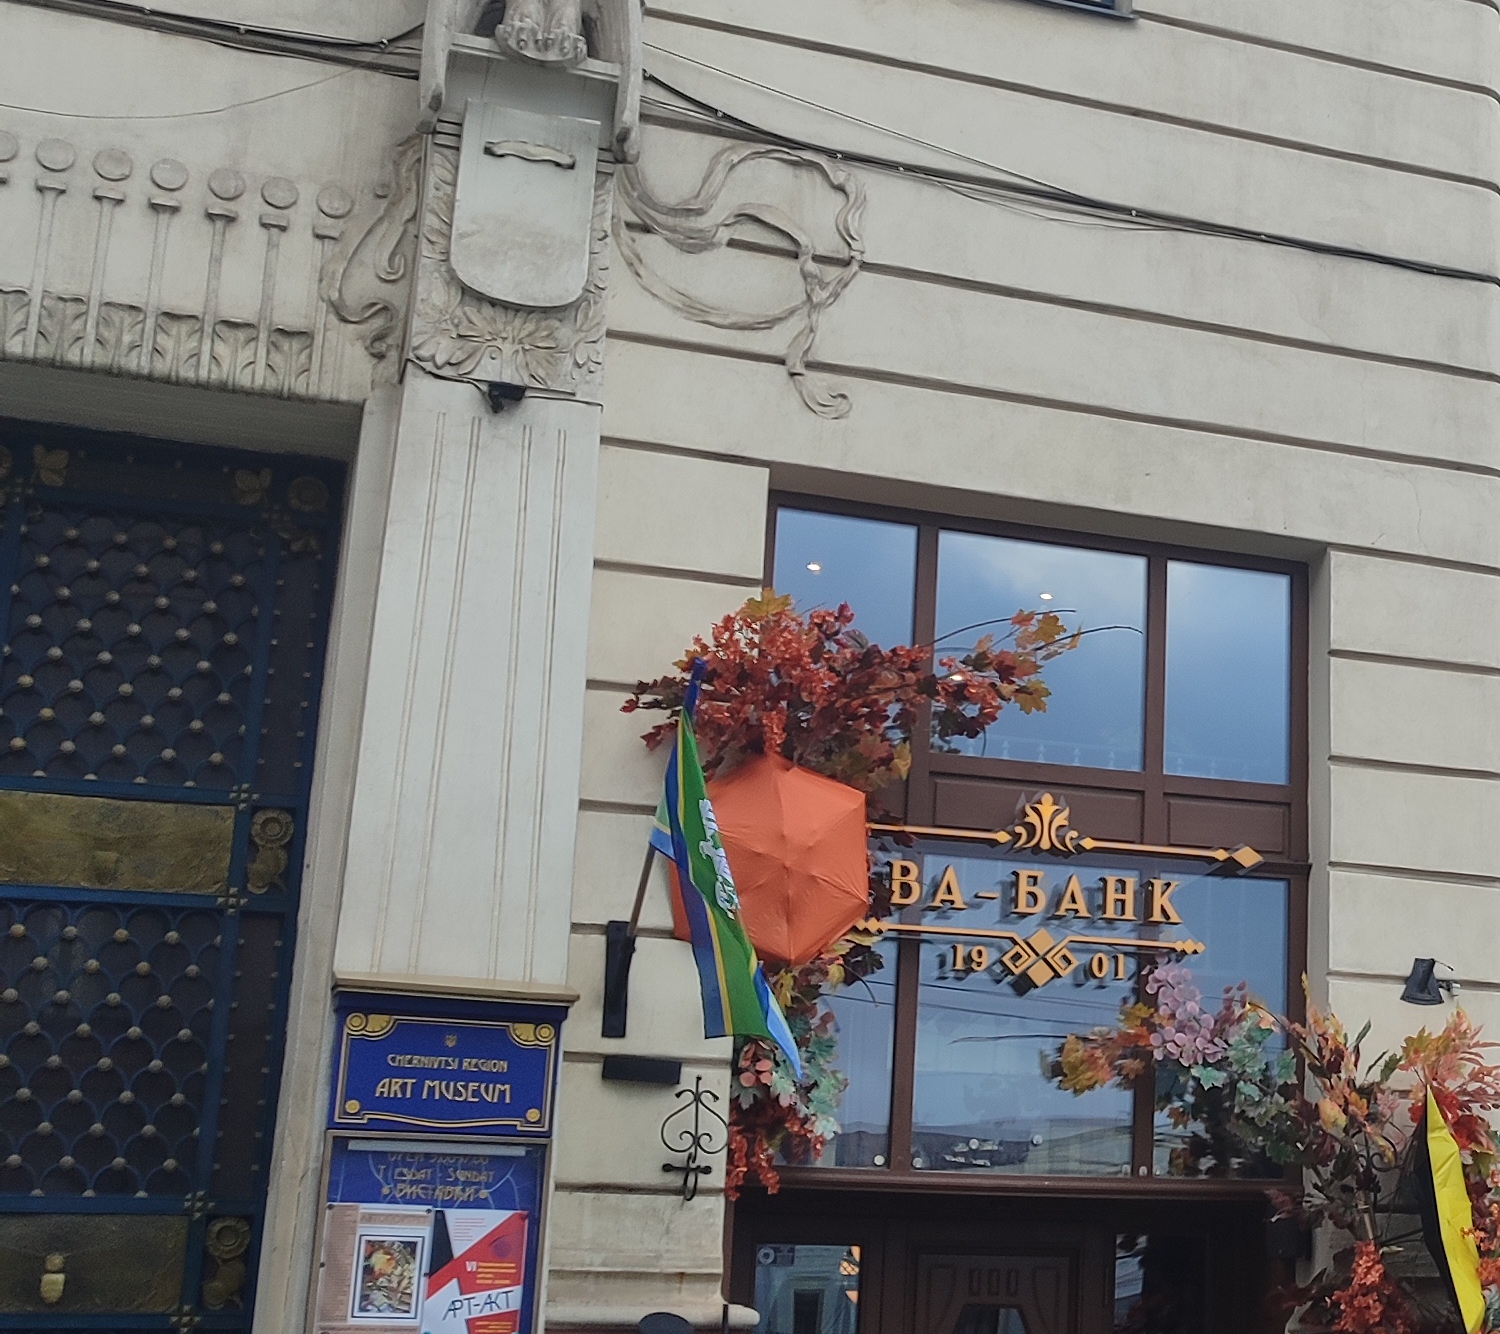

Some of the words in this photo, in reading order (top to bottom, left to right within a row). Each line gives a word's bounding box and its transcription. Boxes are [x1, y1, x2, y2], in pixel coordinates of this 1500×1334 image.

[889, 859, 1183, 924] ВА-БАНК
[952, 943, 989, 971] 19
[1090, 952, 1126, 980] 01
[387, 1054, 460, 1070] CHERNIVTSI
[462, 1058, 508, 1073] REGION
[375, 1078, 417, 1098] ART
[421, 1080, 512, 1104] MUSEUM
